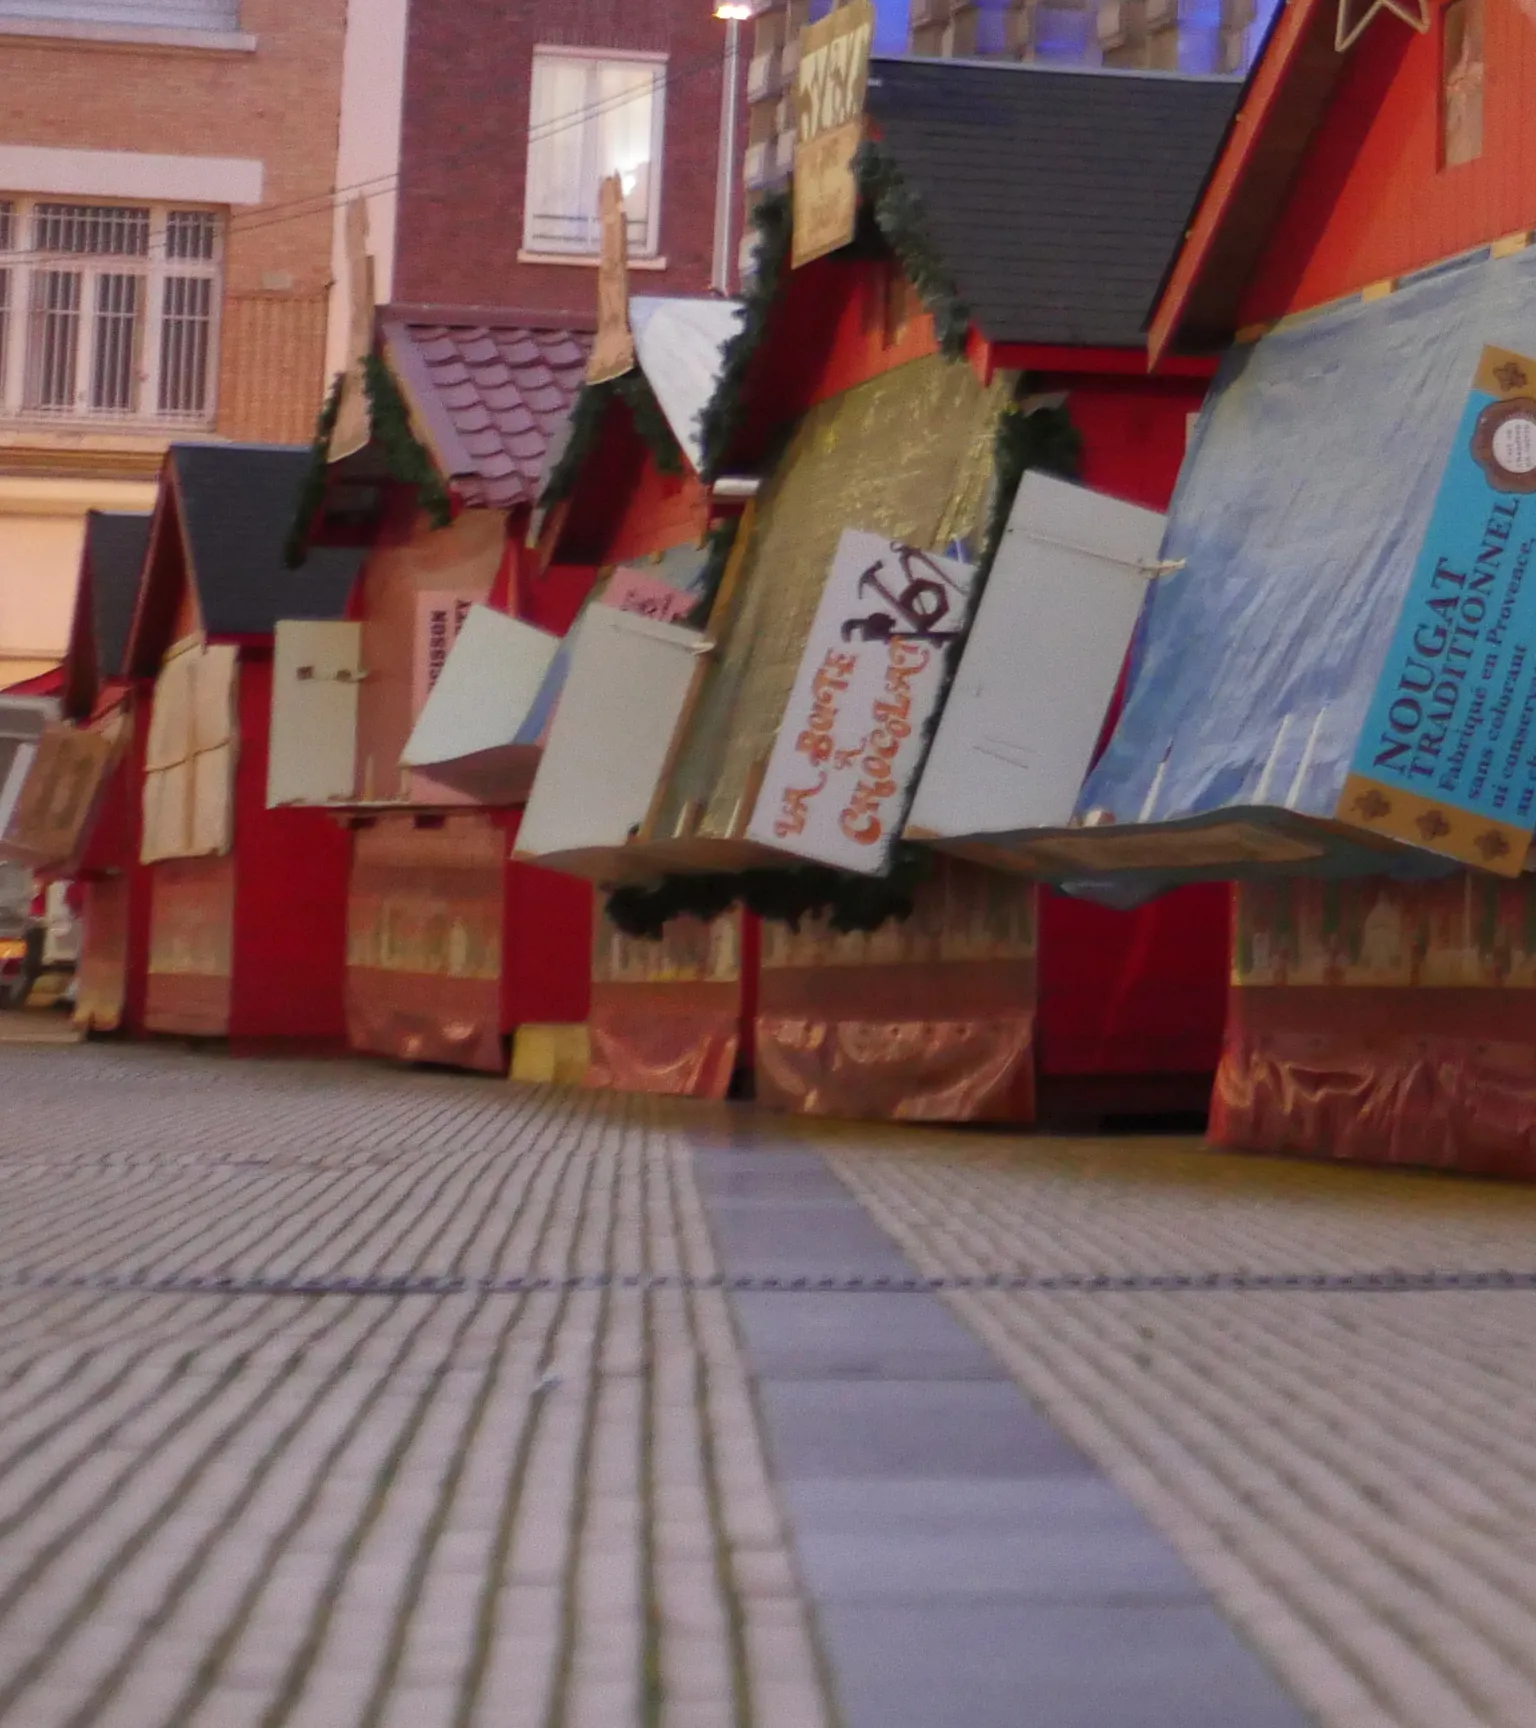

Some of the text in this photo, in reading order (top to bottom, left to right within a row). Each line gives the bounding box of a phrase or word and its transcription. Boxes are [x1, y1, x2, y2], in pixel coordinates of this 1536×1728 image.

[1373, 557, 1466, 771] NOUGAT
[1407, 498, 1520, 780] TRADITIONNEL
[838, 635, 931, 845] CHOCOLAT
[1438, 687, 1488, 791] Fabriqué
[1482, 653, 1498, 680] en
[1468, 643, 1528, 801] sans colorant
[774, 771, 828, 839] LA
[1493, 785, 1509, 809] ni
[1517, 789, 1535, 818] au
